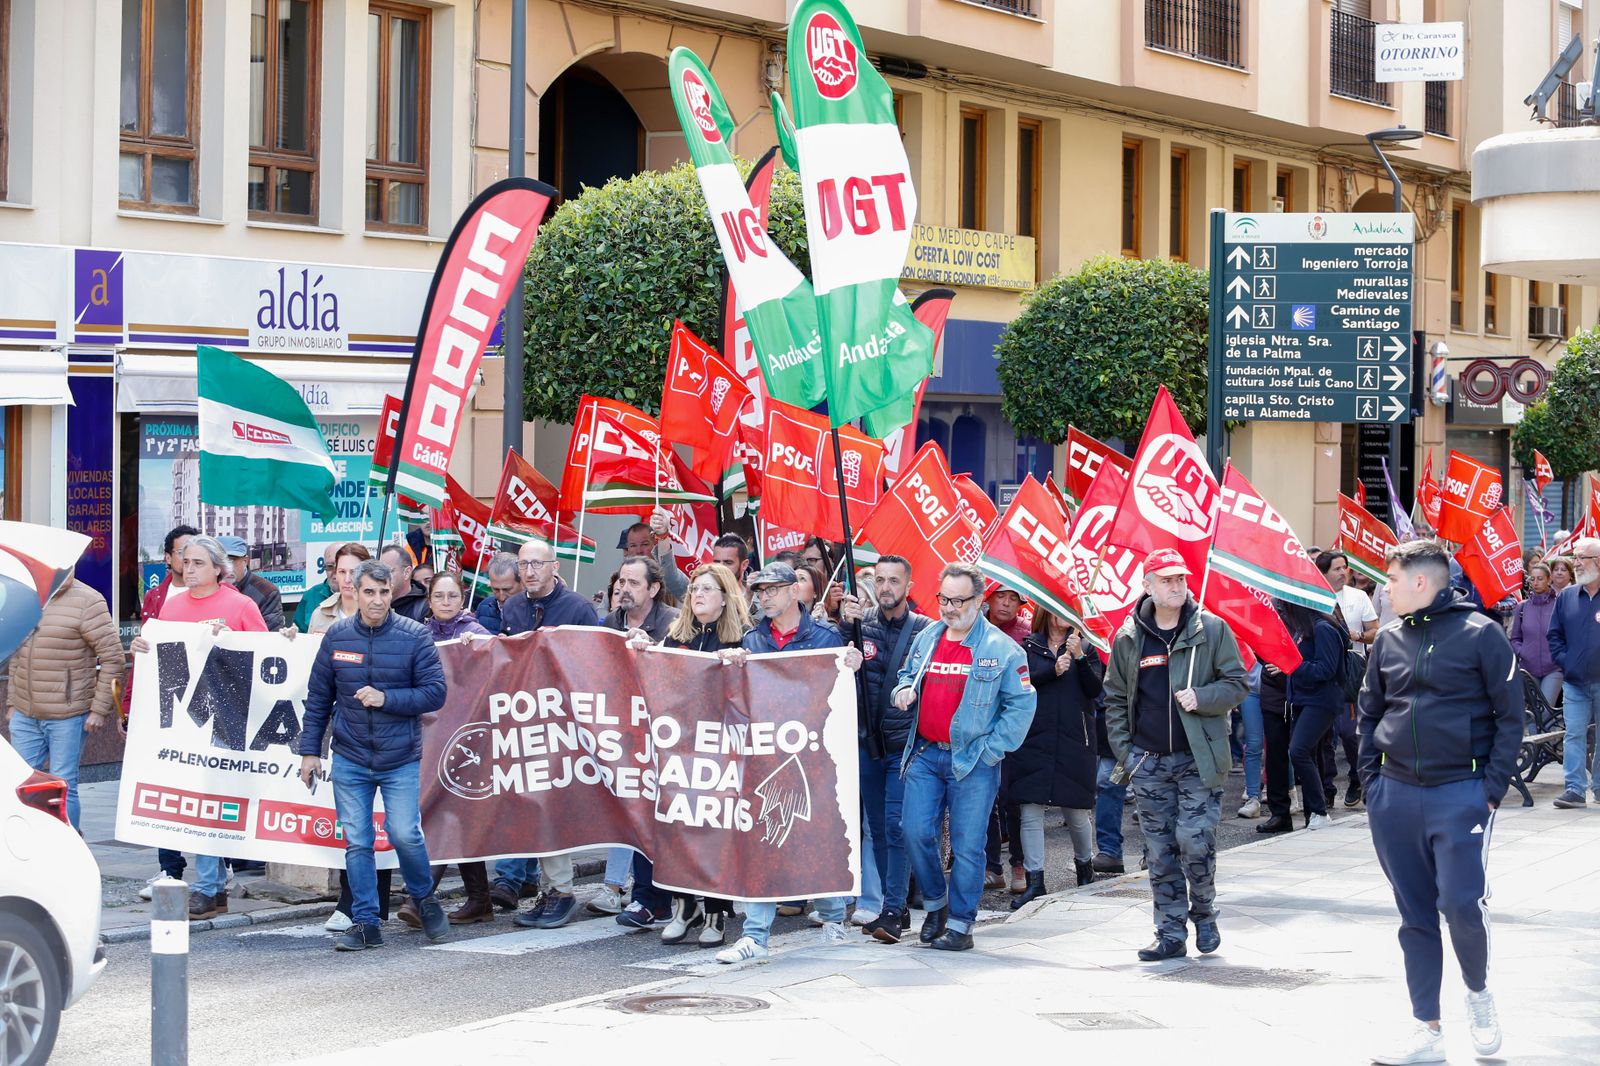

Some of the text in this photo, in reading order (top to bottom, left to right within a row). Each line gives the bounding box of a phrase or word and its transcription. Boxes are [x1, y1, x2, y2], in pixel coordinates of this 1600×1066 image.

[811, 27, 848, 61] UGT
[1380, 46, 1458, 60] OTORRINO
[721, 208, 768, 263] UG
[939, 228, 980, 247] MEDICO
[985, 233, 1014, 250] CALPE
[915, 245, 1000, 269] OFERTA LOW COST
[1354, 246, 1408, 256] mercado
[1302, 258, 1408, 270] Ingeniero Torroja
[917, 268, 942, 283] CARNET
[944, 271, 951, 283] DE
[953, 272, 986, 285] CONDUCIR
[1354, 276, 1408, 286] murallas
[257, 267, 340, 332] aldía
[1337, 289, 1408, 300] Medievales
[1331, 305, 1400, 316] Camino de
[418, 210, 522, 447] CCOO
[1343, 319, 1399, 331] Santiago
[258, 335, 342, 349] GRUPO INMOBILIARIO
[1226, 335, 1332, 347] iglesia Ntra. Sra.
[1226, 348, 1301, 359] de la Palma
[1226, 366, 1332, 378] fundación Mpal. de
[1225, 377, 1353, 388] cultura José Luis Cano
[1225, 395, 1334, 407] capilla Sto. Cristo
[1225, 407, 1310, 418] de la Alameda
[145, 421, 191, 435] PRÓXIMA
[248, 427, 280, 440] CCOO
[146, 438, 155, 452] 1ª
[157, 441, 165, 454] y
[167, 438, 178, 452] 2ª
[343, 440, 365, 452] LUIS
[412, 442, 448, 471] Cádiz
[771, 443, 815, 475] PSOE
[67, 470, 113, 483] VIVIENDAS
[1146, 439, 1220, 512] UGT
[68, 487, 112, 499] LOCALES
[1446, 477, 1470, 498] PSOE
[906, 472, 949, 527] PSOE
[68, 504, 112, 516] GARAJES
[68, 520, 112, 532] SOLARES
[311, 522, 374, 533] DE ALGECIRAS
[768, 531, 805, 551] Cádiz
[1483, 520, 1504, 551] PSOE
[926, 662, 960, 674] COO
[489, 687, 567, 723] POR
[570, 692, 619, 725] EL
[492, 722, 623, 761] MENOS
[157, 748, 279, 775] #PLENOEMPLEO
[493, 755, 656, 801] MEJORES
[138, 789, 220, 820] CCOO
[264, 810, 312, 834] UGT
[152, 823, 182, 832] comarcal
[184, 827, 207, 837] Campo
